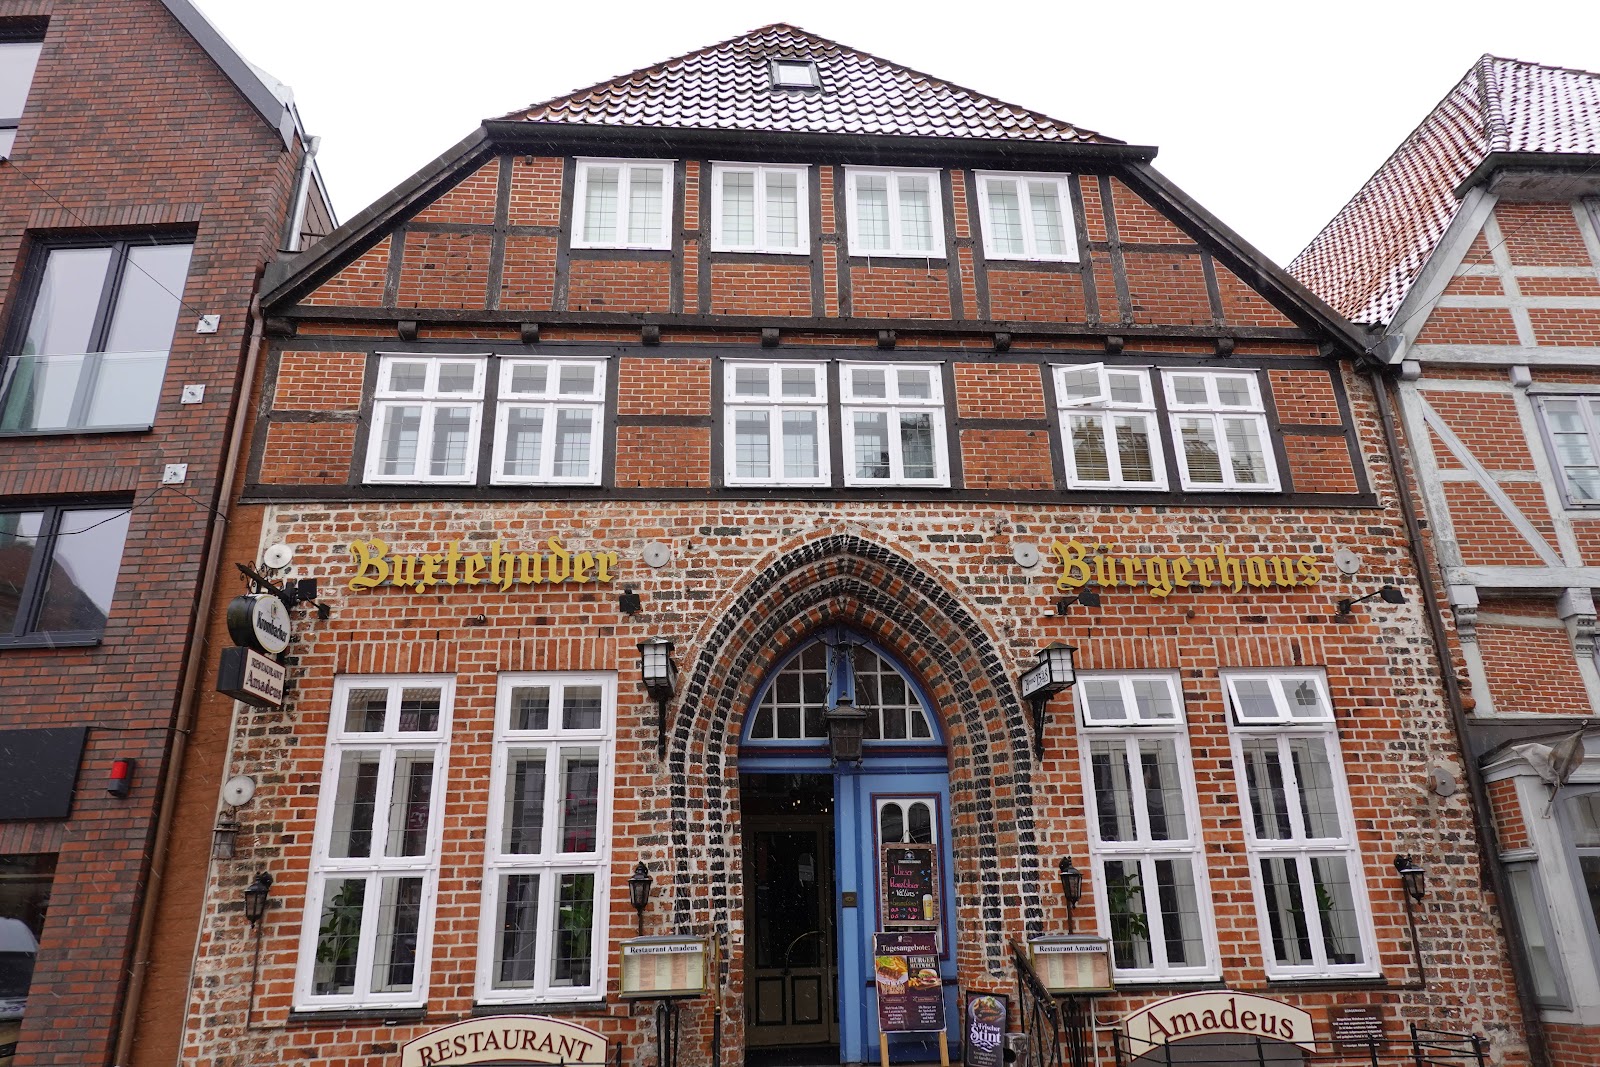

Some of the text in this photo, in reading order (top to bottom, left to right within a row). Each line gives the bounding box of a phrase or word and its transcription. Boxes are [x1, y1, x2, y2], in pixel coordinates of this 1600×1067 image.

[349, 535, 619, 594] Buxtehuder
[1051, 539, 1321, 598] Bürgerhaus
[256, 610, 288, 643] Krombacher
[245, 669, 282, 700] Amadeus
[251, 657, 283, 681] RESTAURANT
[630, 944, 698, 954] Restaurant Amadeus
[881, 944, 931, 953] Tagesangebote:
[970, 1024, 1001, 1044] Stint
[977, 1022, 1001, 1032] Frischer
[1147, 997, 1295, 1047] Amadeus
[417, 1029, 593, 1066] RESTAURANT
